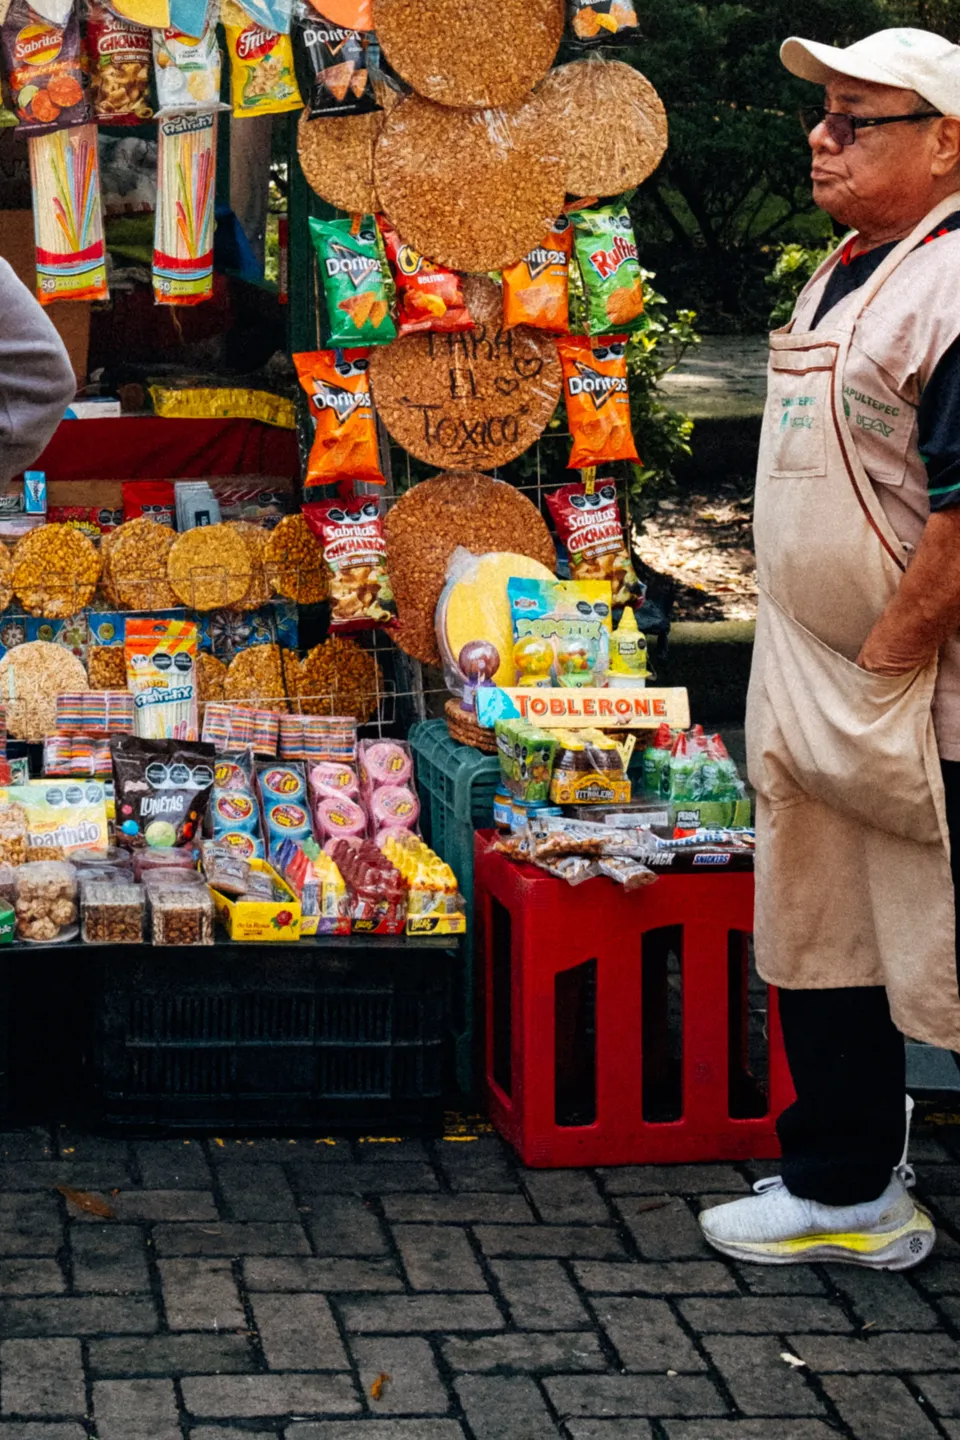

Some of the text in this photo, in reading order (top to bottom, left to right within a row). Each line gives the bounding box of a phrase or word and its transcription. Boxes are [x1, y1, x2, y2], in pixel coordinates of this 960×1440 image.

[14, 31, 64, 58] Sabritas
[325, 256, 383, 276] Doritos
[568, 376, 628, 396] Doritos
[311, 391, 372, 410] Doritos
[568, 508, 617, 531] Sabritas
[325, 524, 377, 542] Sabritas
[515, 694, 668, 718] TOBLERONE
[139, 796, 185, 817] LUNETAS
[693, 854, 731, 866] SNICKERS
